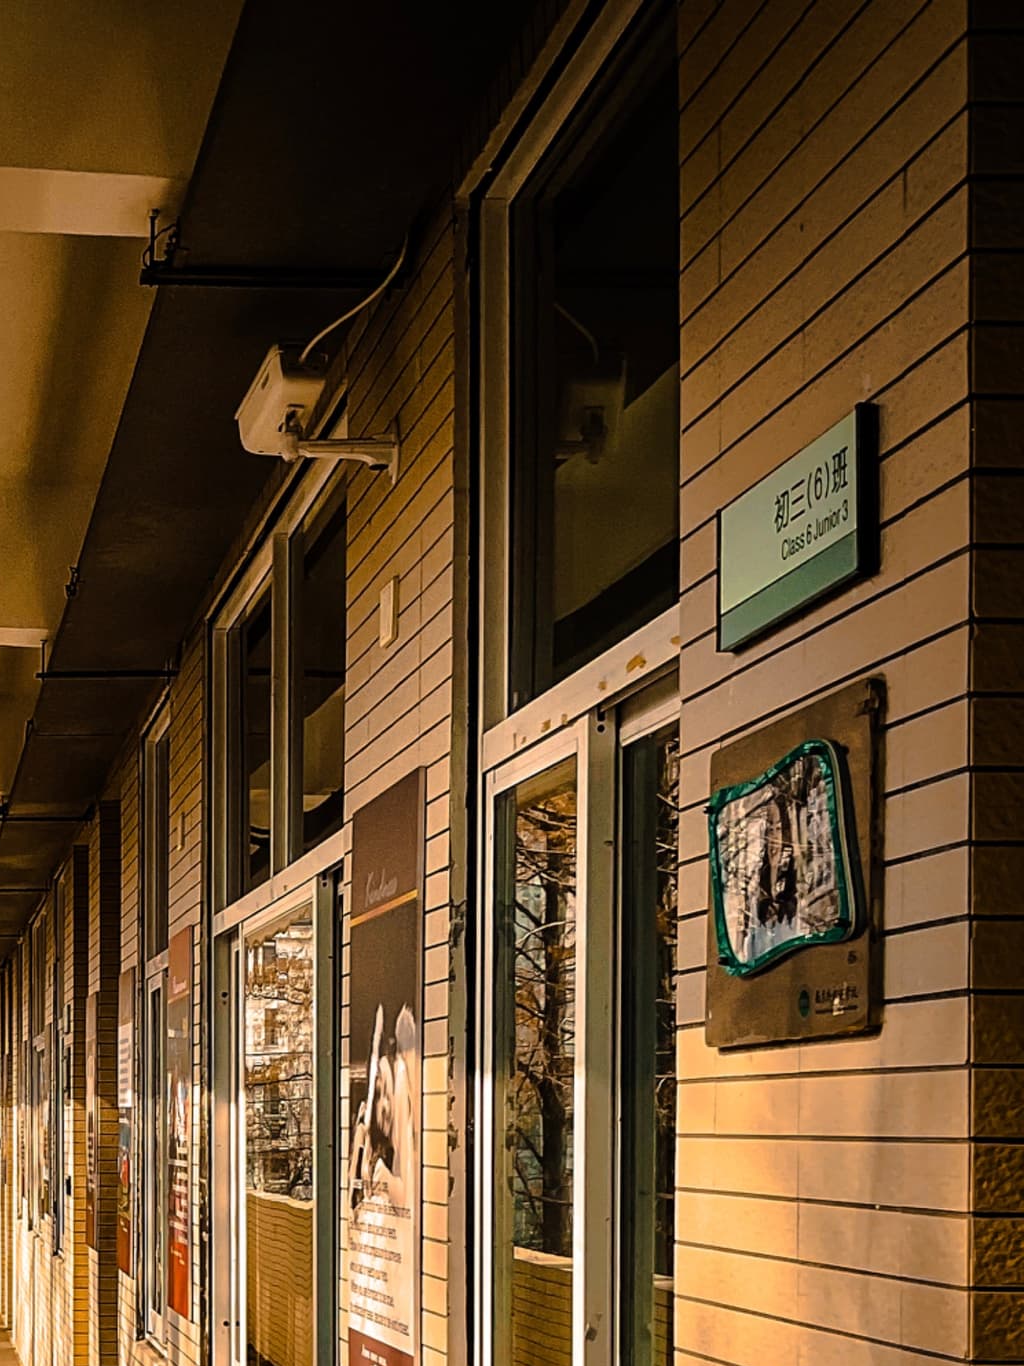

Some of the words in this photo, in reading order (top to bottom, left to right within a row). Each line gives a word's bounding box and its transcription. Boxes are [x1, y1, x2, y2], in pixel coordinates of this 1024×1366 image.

[774, 446, 848, 533] 初三(6)班
[781, 532, 805, 560] Class
[806, 523, 813, 545] 6
[813, 510, 841, 541] Junior
[841, 499, 849, 522] 3
